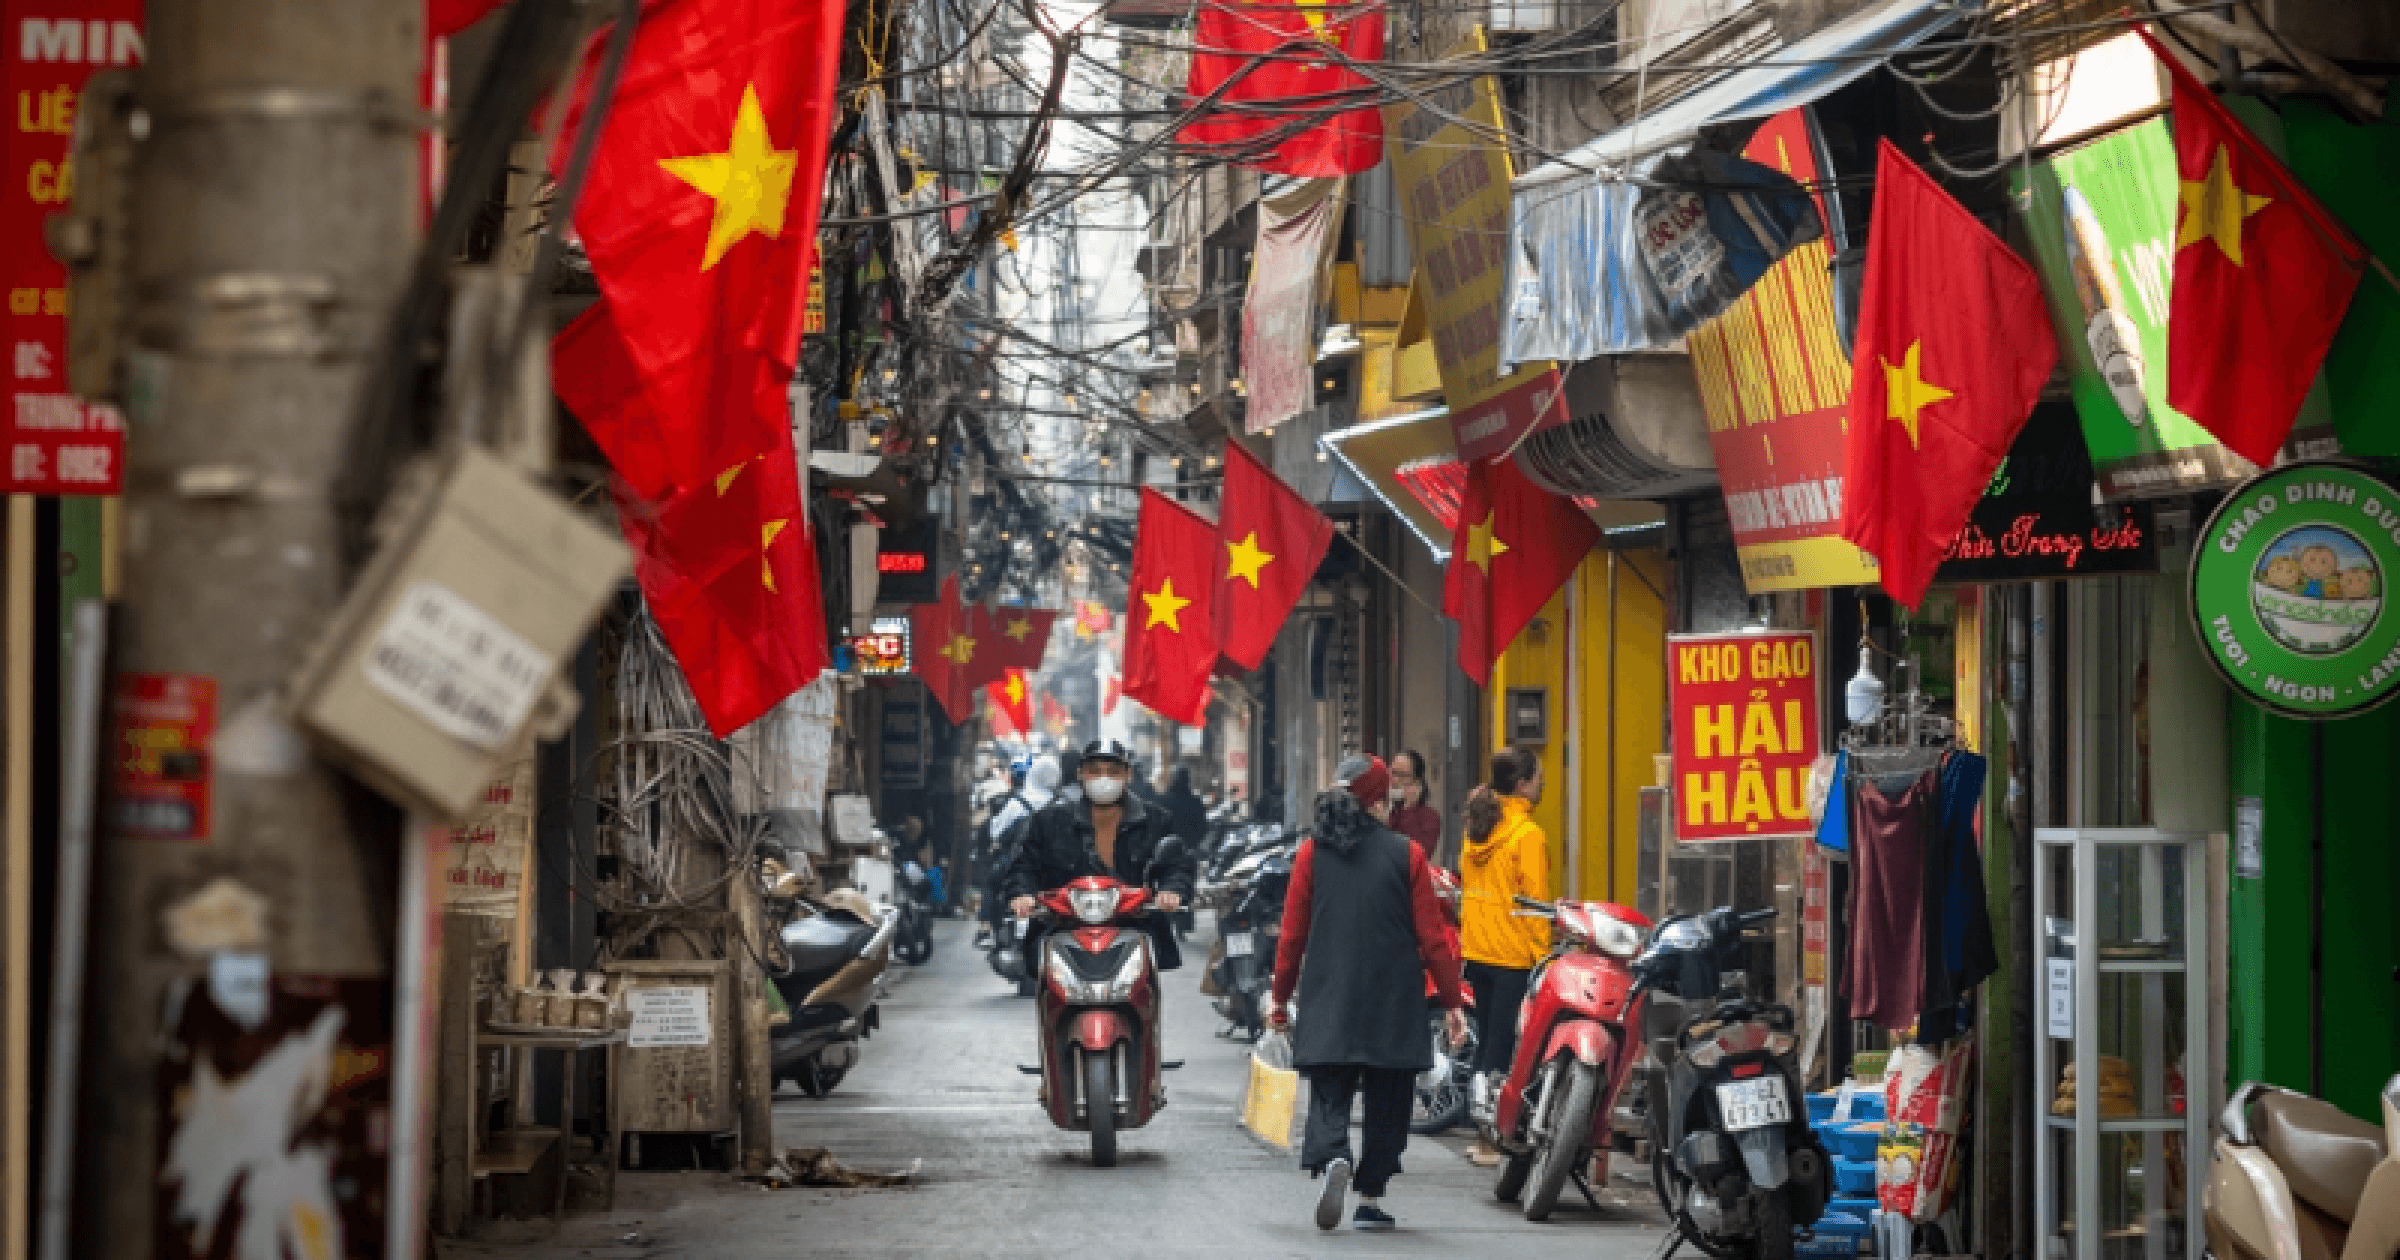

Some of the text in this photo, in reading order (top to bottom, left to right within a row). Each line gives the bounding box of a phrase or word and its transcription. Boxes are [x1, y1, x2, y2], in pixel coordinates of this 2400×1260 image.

[1679, 639, 1811, 687] KHO GẠO
[2264, 675, 2336, 703] NGON
[1692, 687, 1804, 759] HẢI
[1682, 757, 1814, 832] HẬU
